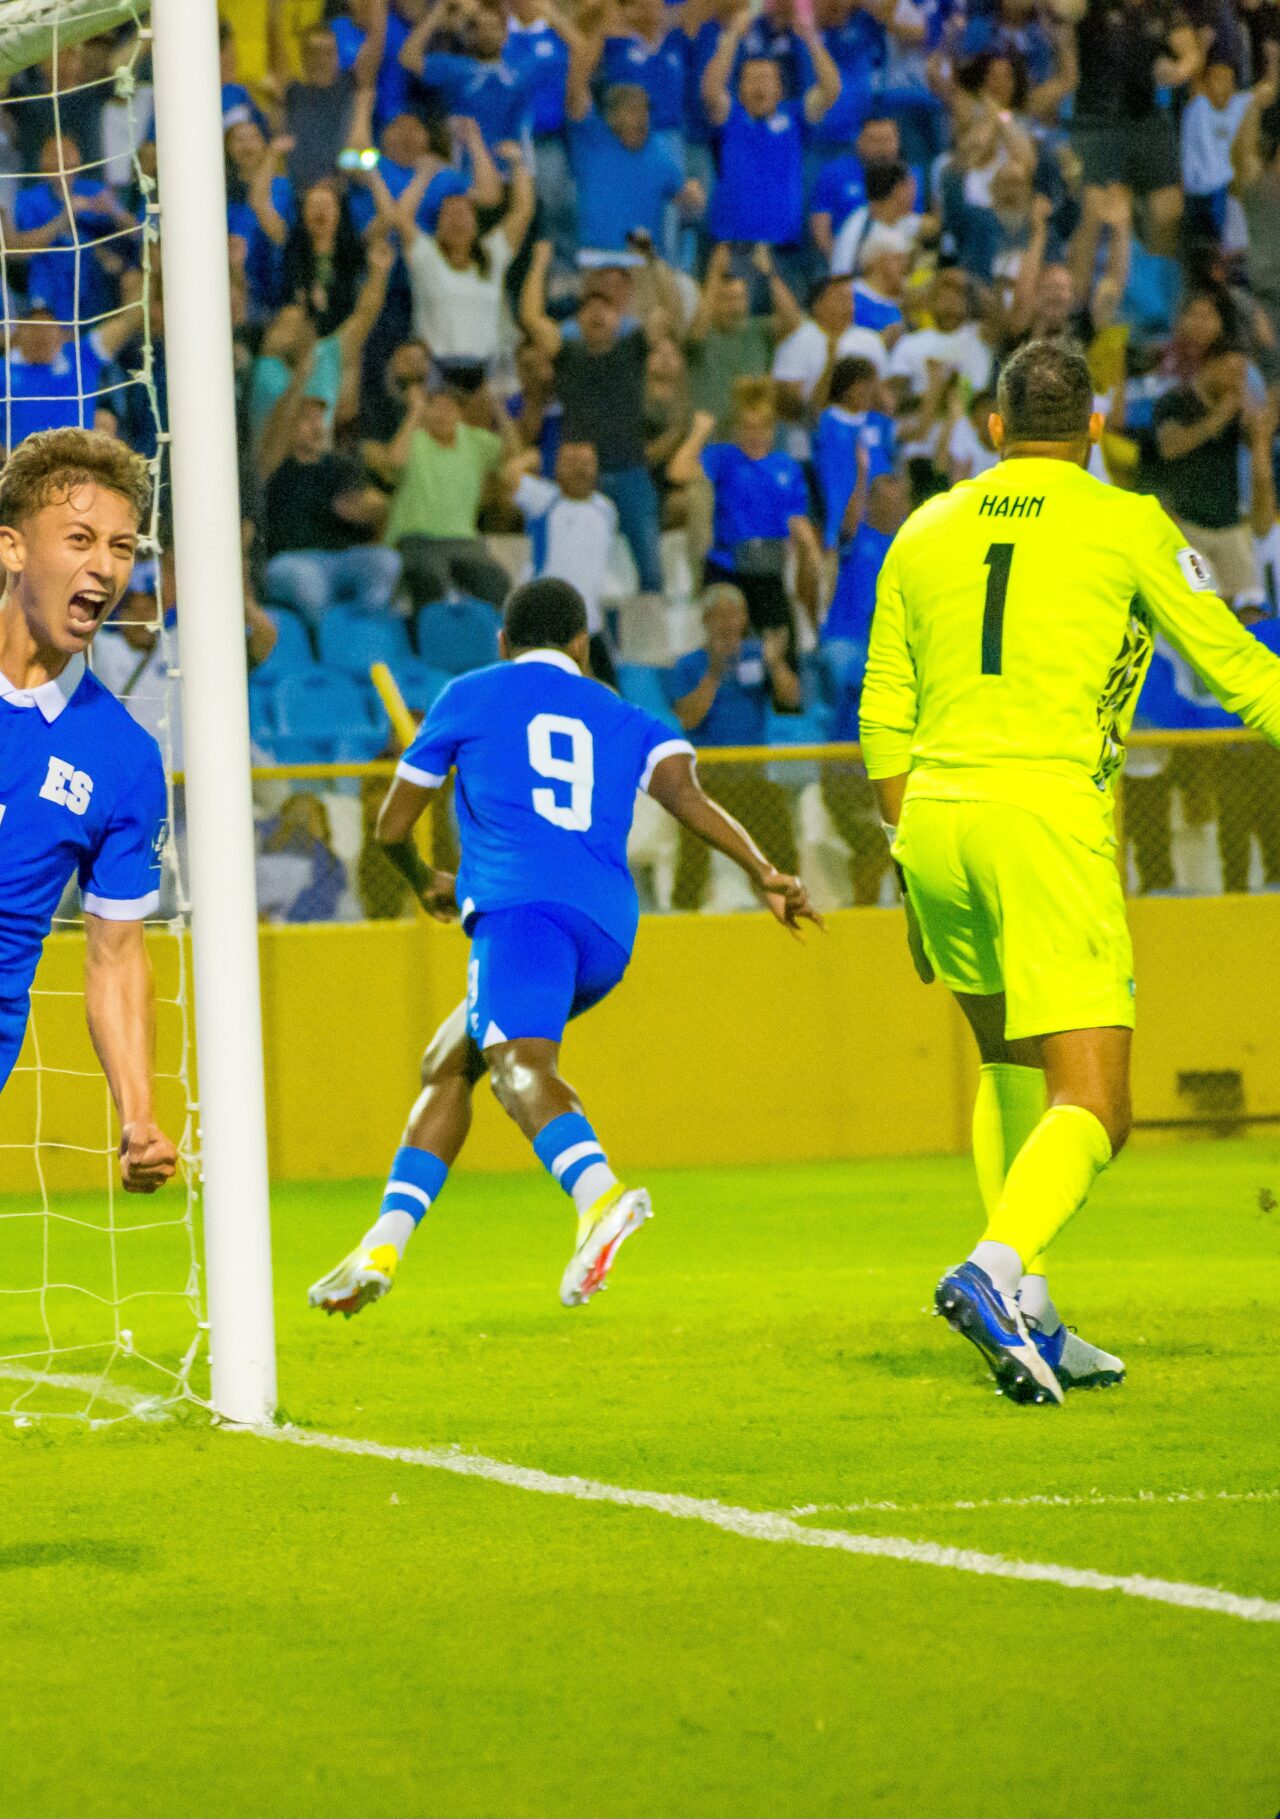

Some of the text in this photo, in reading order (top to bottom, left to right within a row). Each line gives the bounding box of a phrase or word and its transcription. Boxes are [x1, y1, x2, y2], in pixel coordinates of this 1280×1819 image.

[978, 495, 1046, 518] HAHN
[981, 542, 1015, 676] 1
[39, 756, 93, 815] ES
[527, 713, 594, 832] 9
